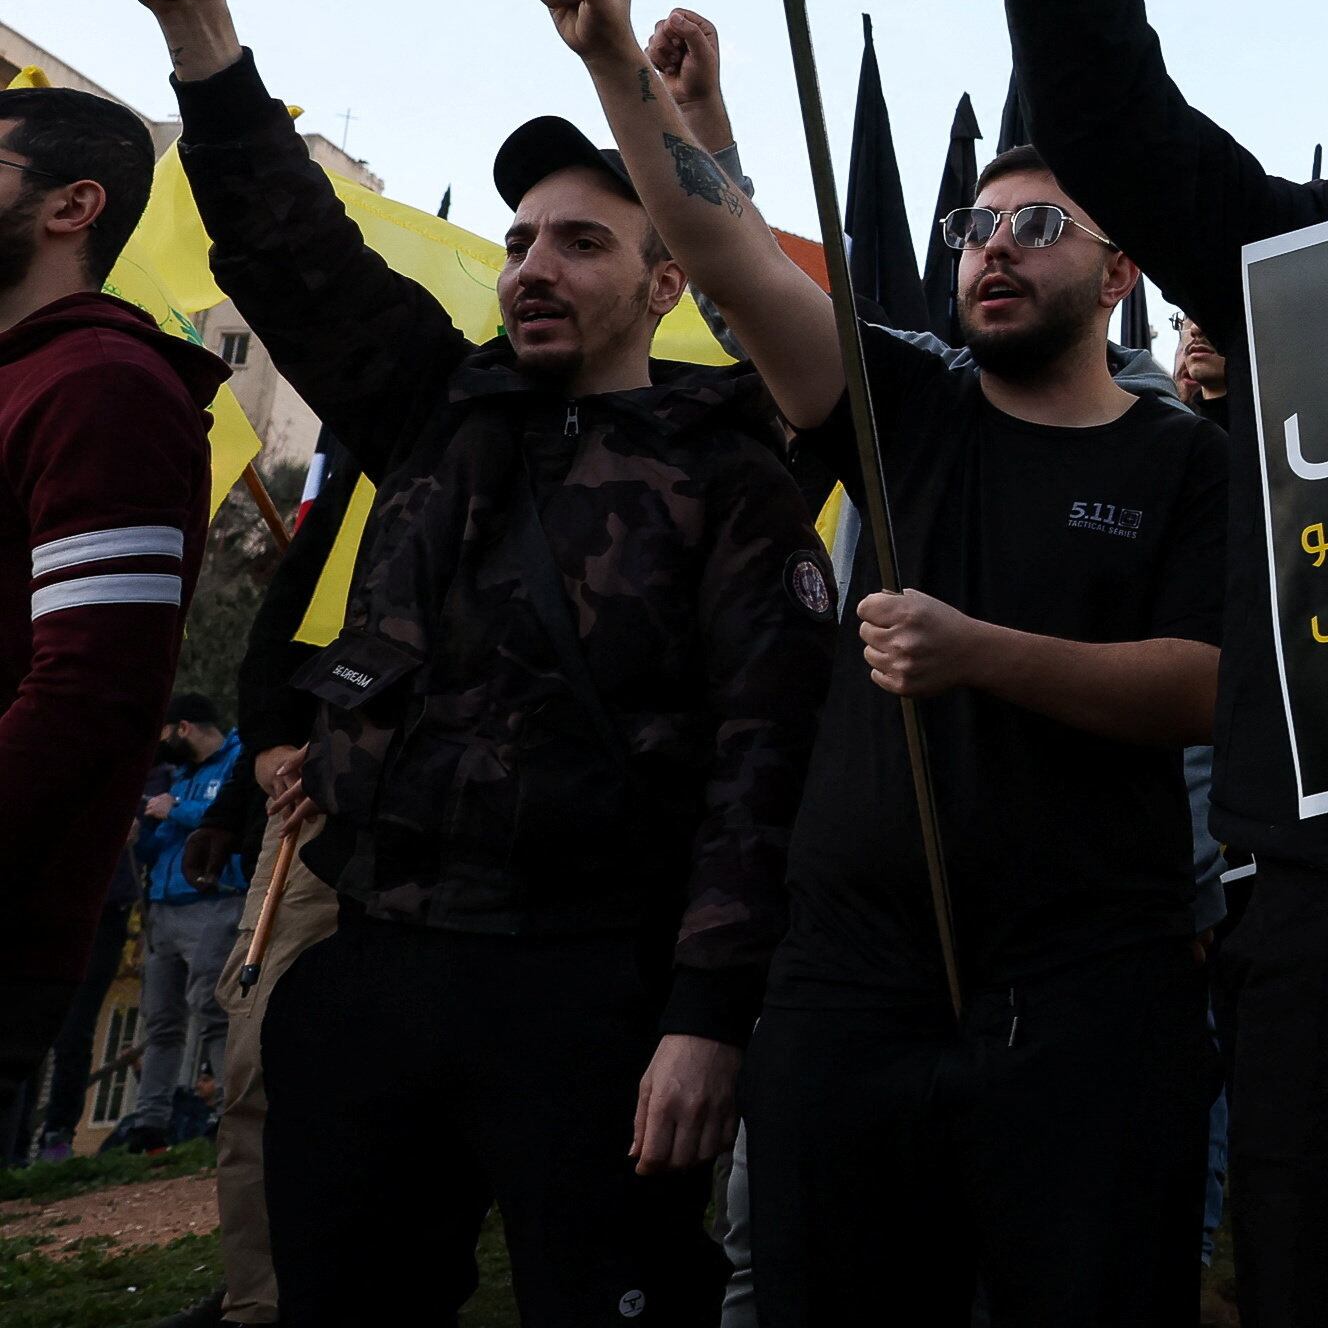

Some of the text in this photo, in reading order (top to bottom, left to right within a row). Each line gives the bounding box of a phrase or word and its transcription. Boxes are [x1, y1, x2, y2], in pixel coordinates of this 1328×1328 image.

[1069, 501, 1115, 525] 5.11
[1068, 519, 1138, 539] TACTICAL SERIES
